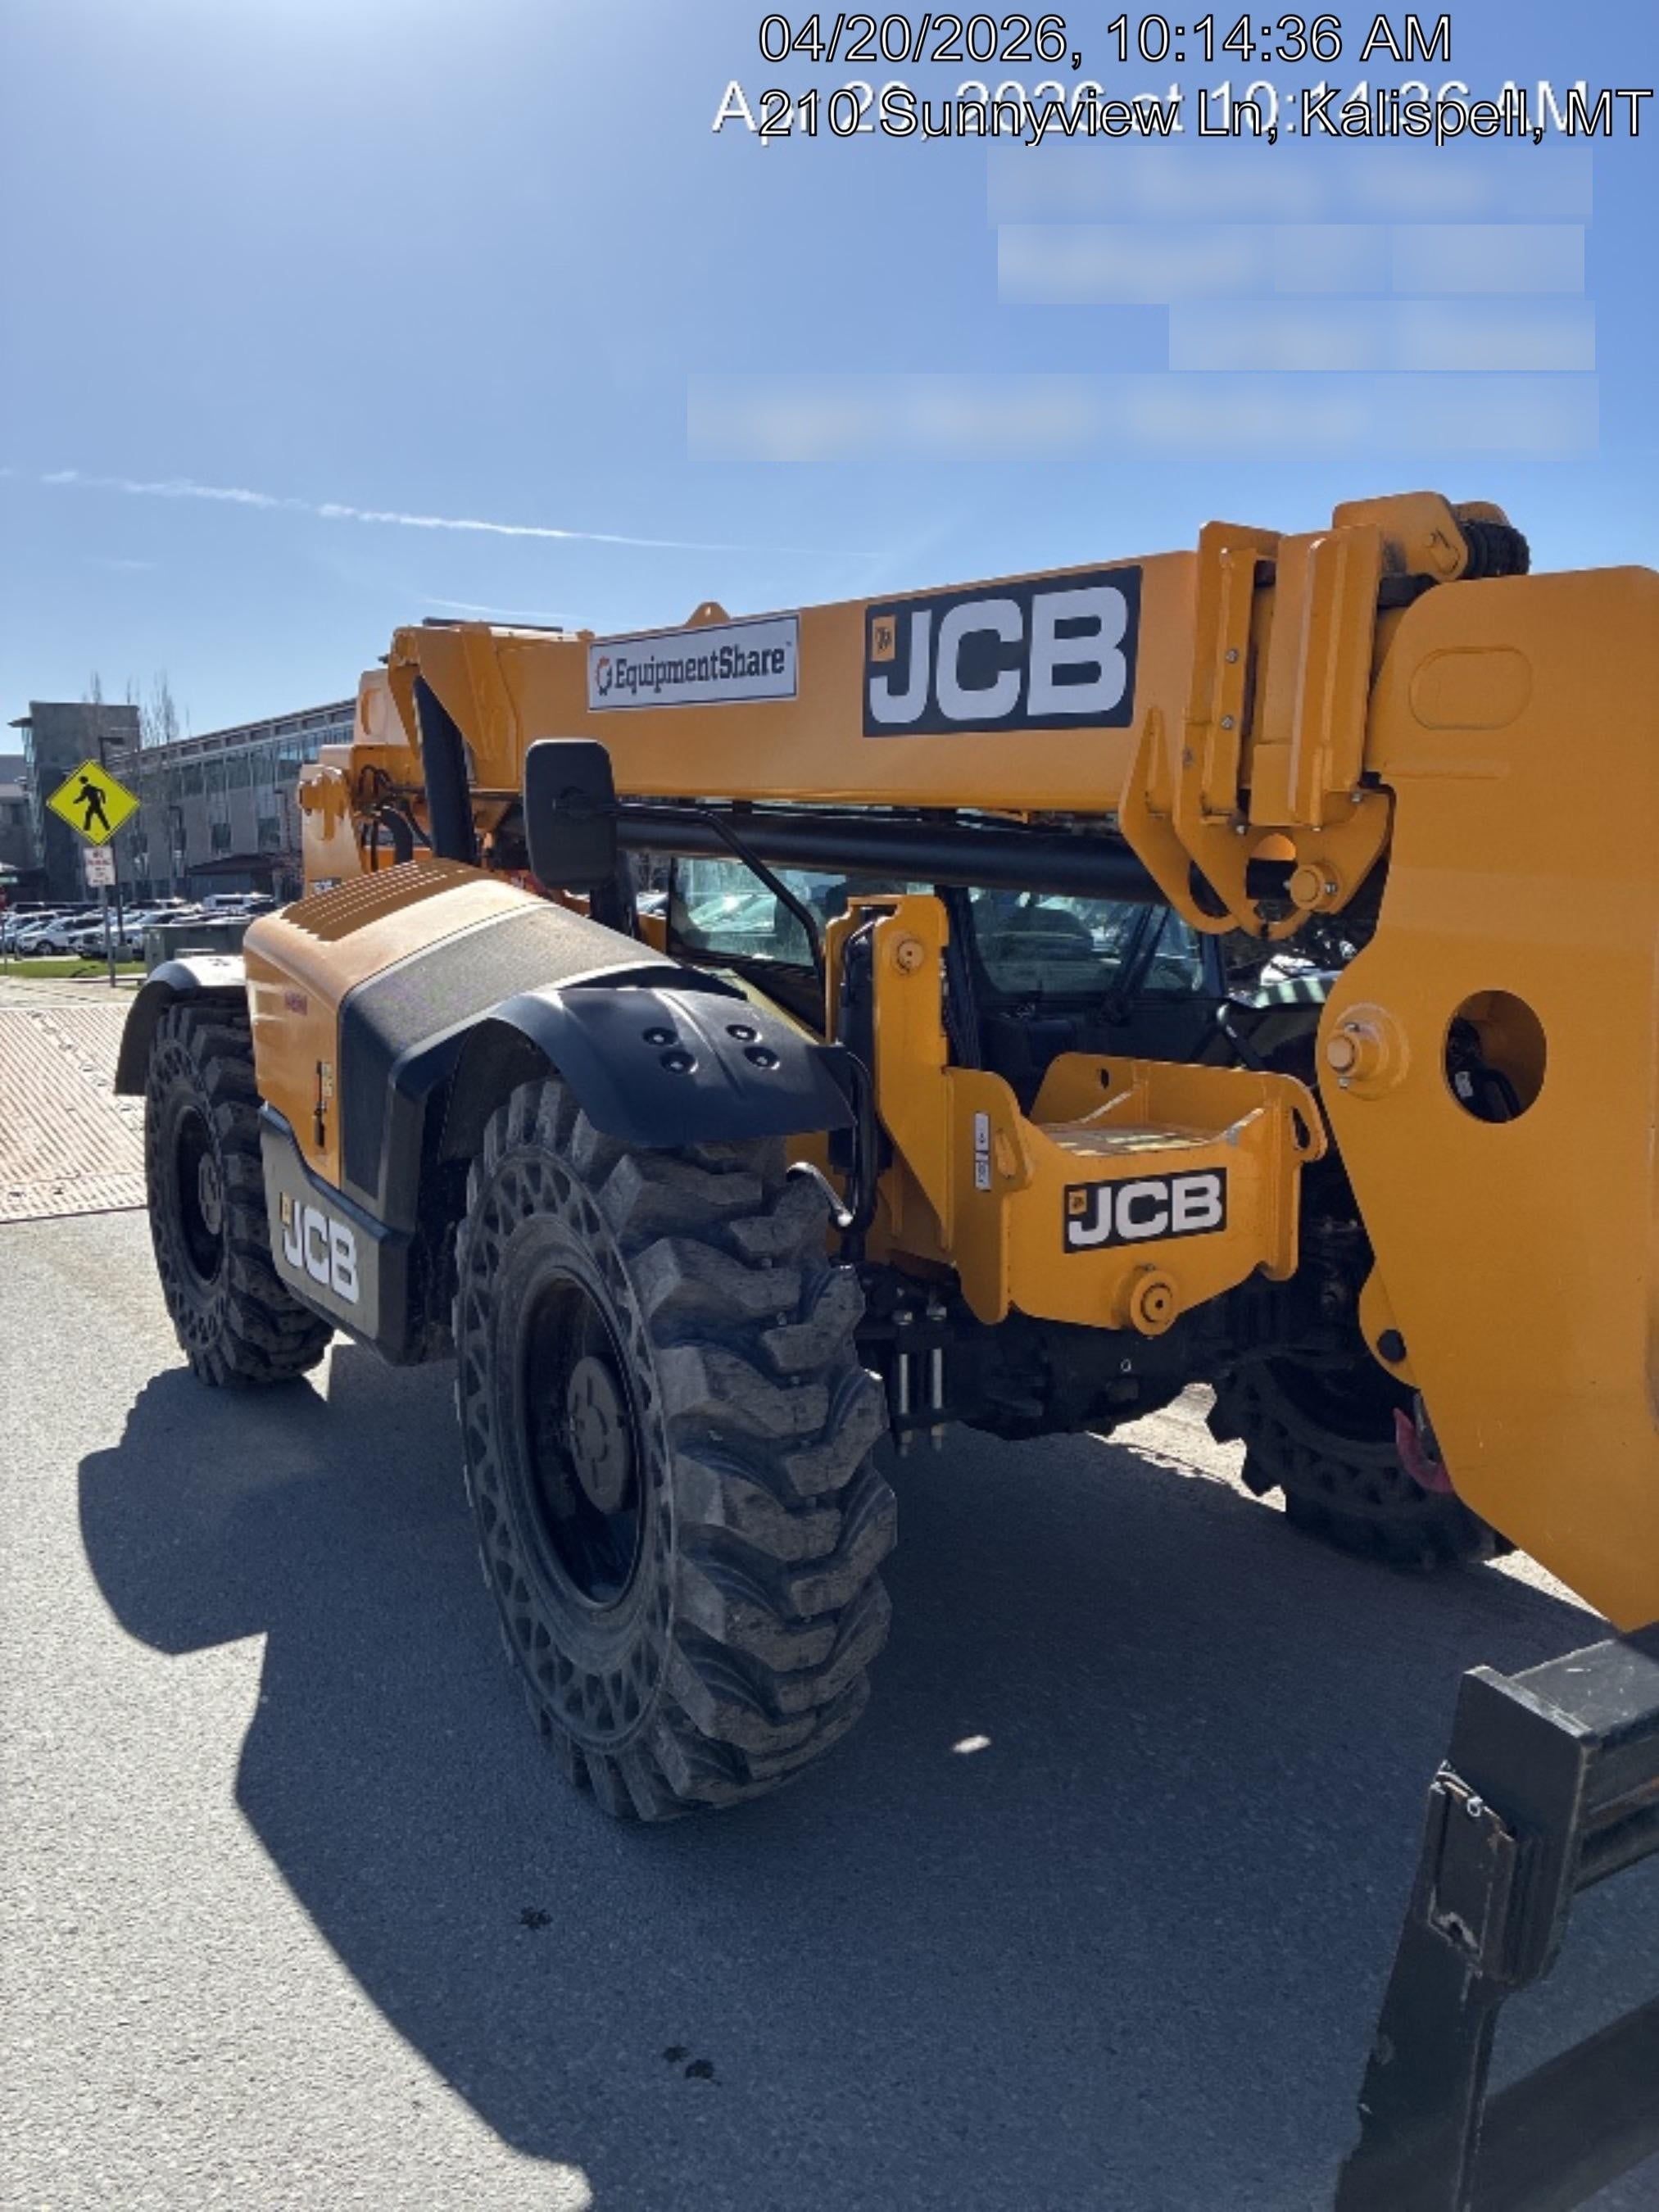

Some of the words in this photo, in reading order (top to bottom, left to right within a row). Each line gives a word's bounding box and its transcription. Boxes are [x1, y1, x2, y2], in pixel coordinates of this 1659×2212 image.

[614, 643, 786, 696] EquipmentShare
[869, 586, 1128, 724] JCB
[282, 1199, 360, 1304] JCB
[1067, 1174, 1223, 1246] JCB
